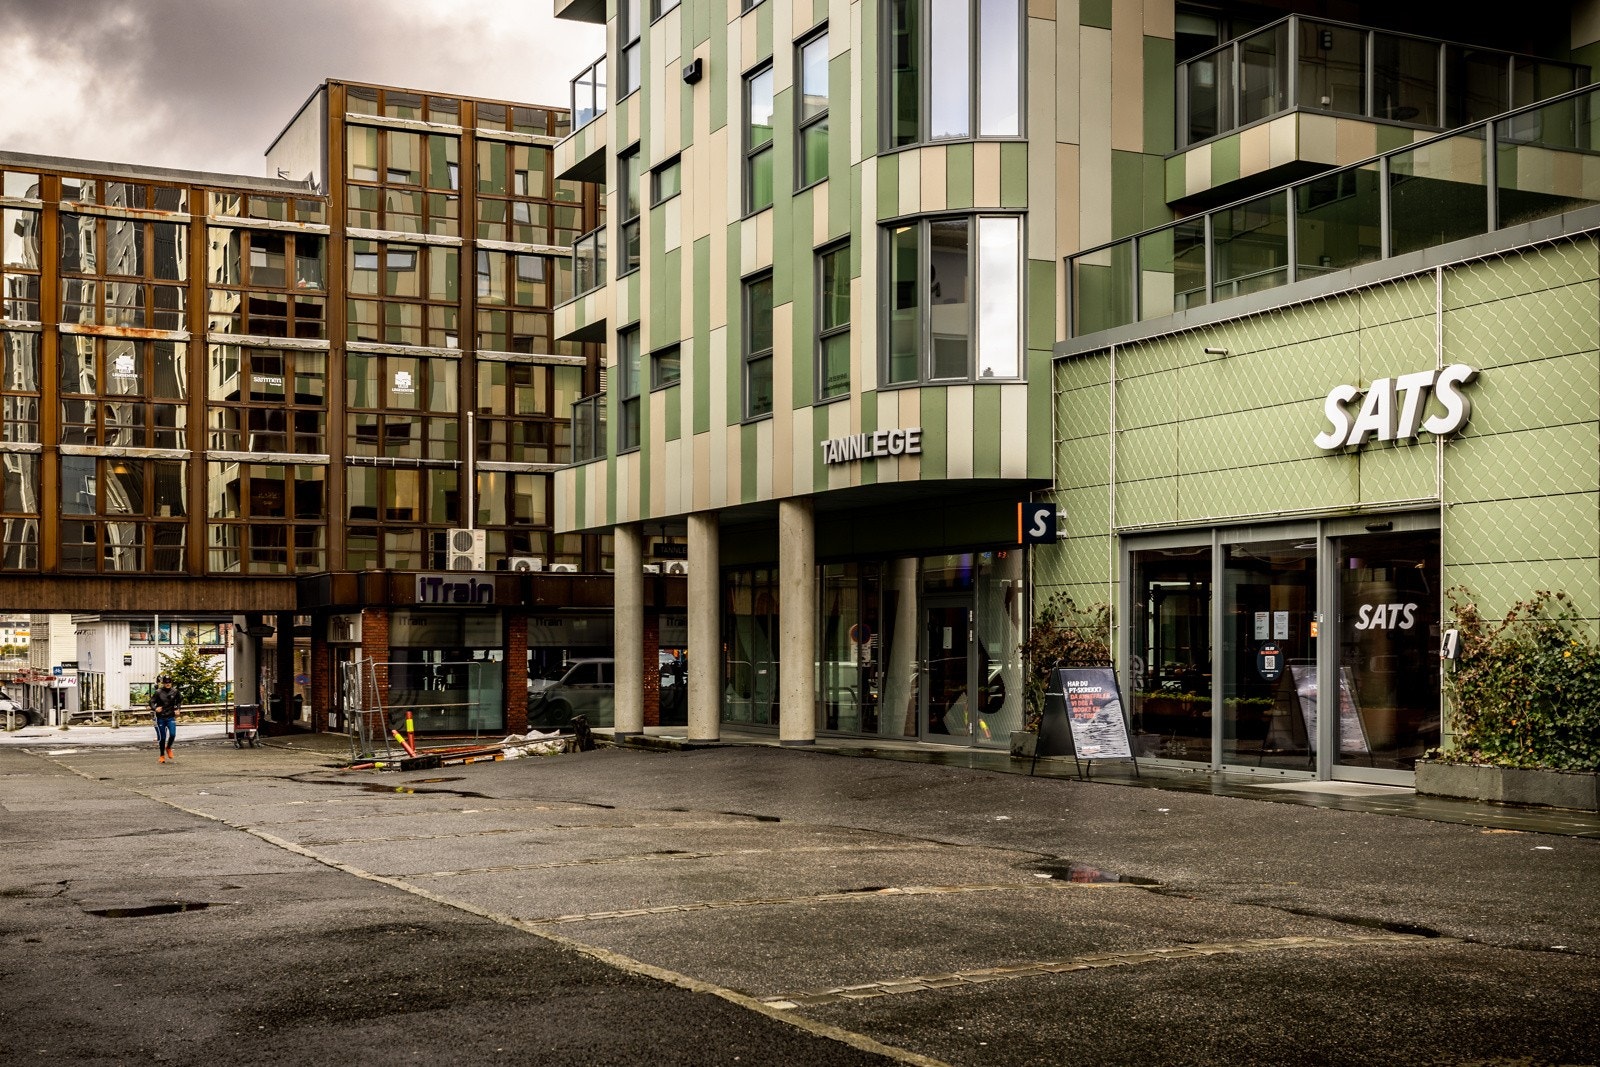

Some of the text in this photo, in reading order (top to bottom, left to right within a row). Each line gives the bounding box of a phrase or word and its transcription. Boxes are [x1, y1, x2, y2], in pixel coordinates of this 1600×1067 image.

[1314, 364, 1479, 450] SATS
[820, 427, 922, 464] TANNLEGE
[1029, 509, 1051, 538] S
[420, 577, 494, 602] iTrain
[399, 616, 428, 626] iTrain
[536, 617, 562, 626] iTrain
[666, 616, 688, 626] iTrai
[1355, 603, 1418, 630] SATS
